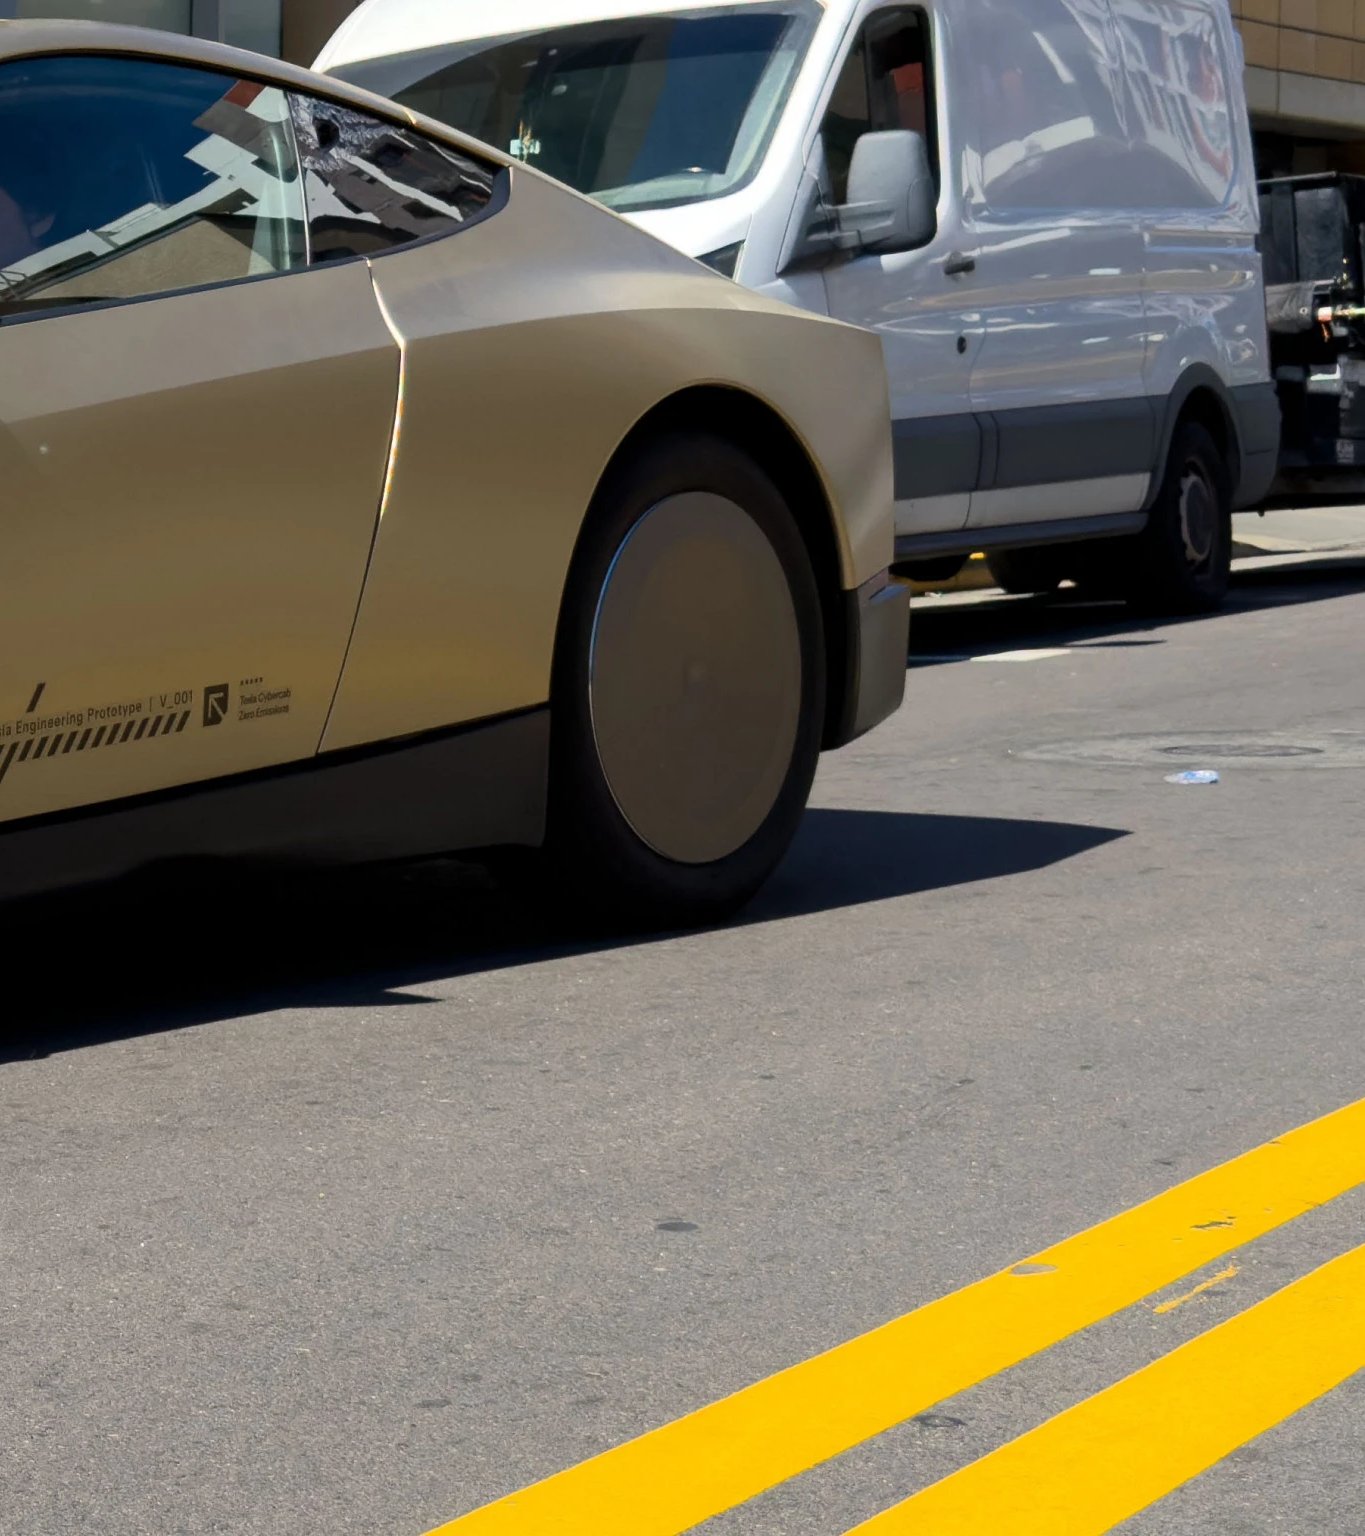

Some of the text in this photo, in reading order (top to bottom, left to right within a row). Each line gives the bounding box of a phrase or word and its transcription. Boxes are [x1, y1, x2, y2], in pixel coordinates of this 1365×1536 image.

[16, 712, 83, 735] Engineering
[87, 701, 142, 724] Prototype
[160, 689, 193, 709] V_001
